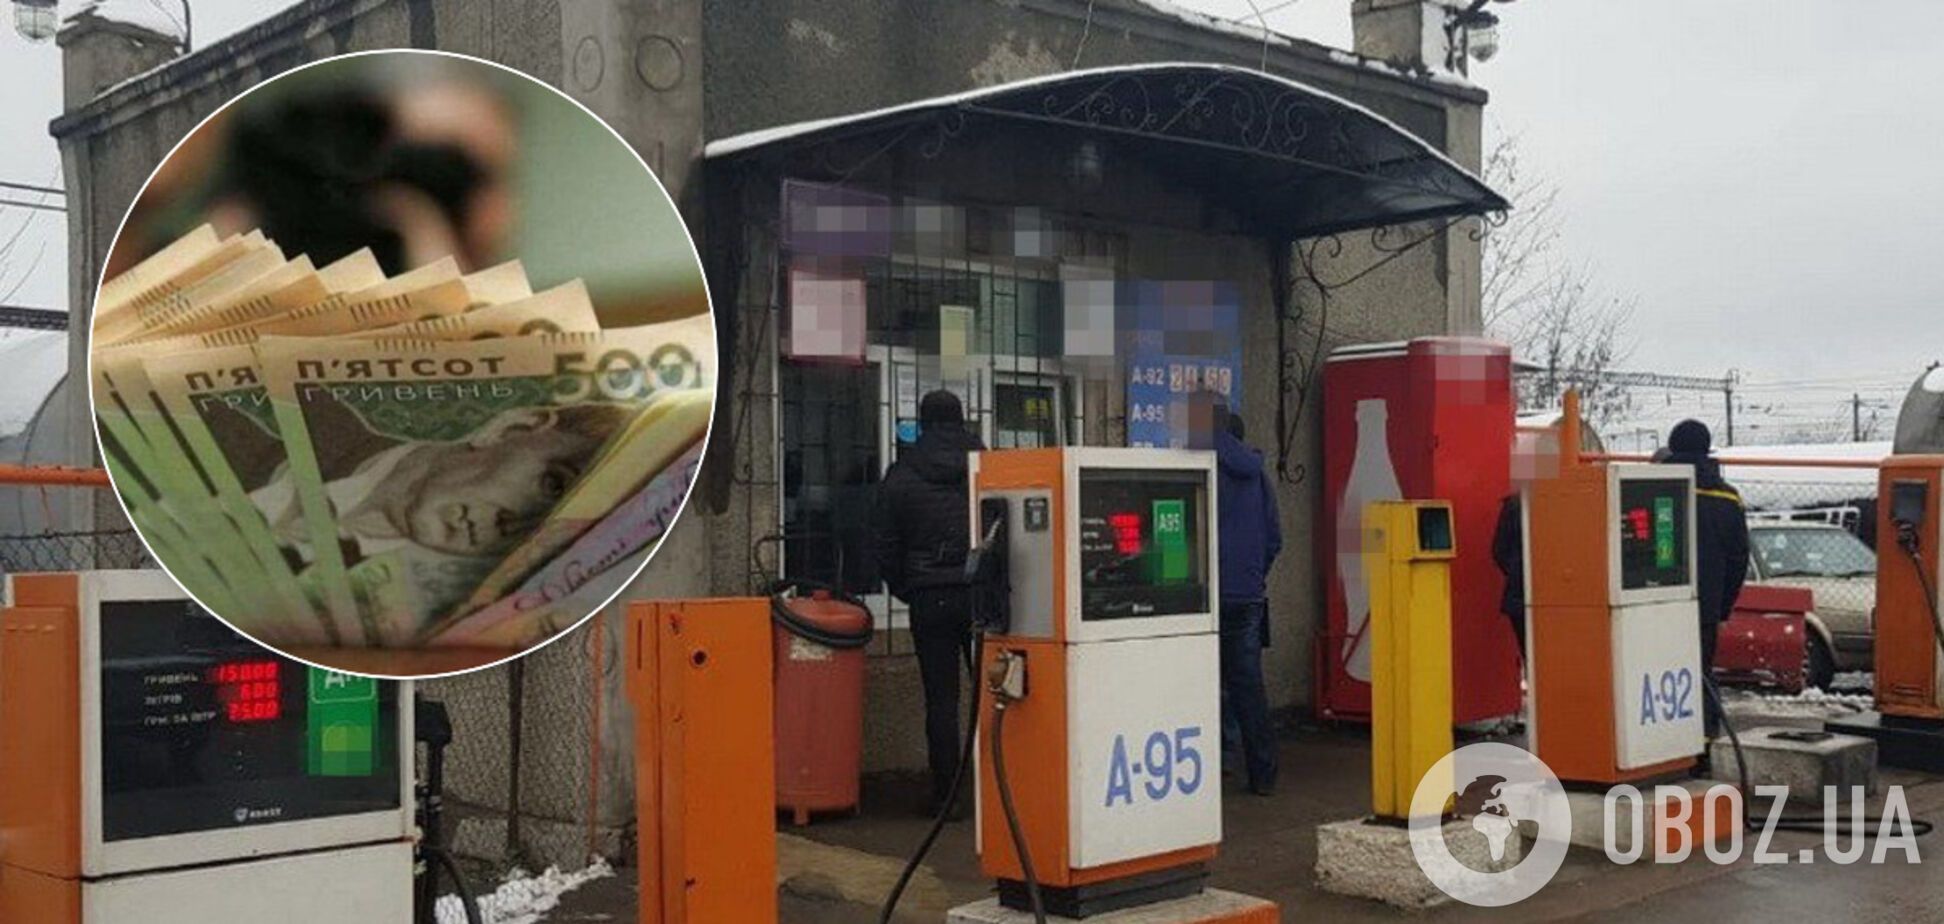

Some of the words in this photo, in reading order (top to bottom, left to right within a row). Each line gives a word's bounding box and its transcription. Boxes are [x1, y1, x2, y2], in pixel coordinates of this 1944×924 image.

[296, 356, 506, 379] П'ЯТСОТ
[550, 343, 697, 403] 500
[303, 382, 515, 402] ГРИВЕНЬ
[1131, 403, 1165, 422] А-95
[1640, 667, 1694, 726] А-92
[1104, 726, 1202, 808] А-95
